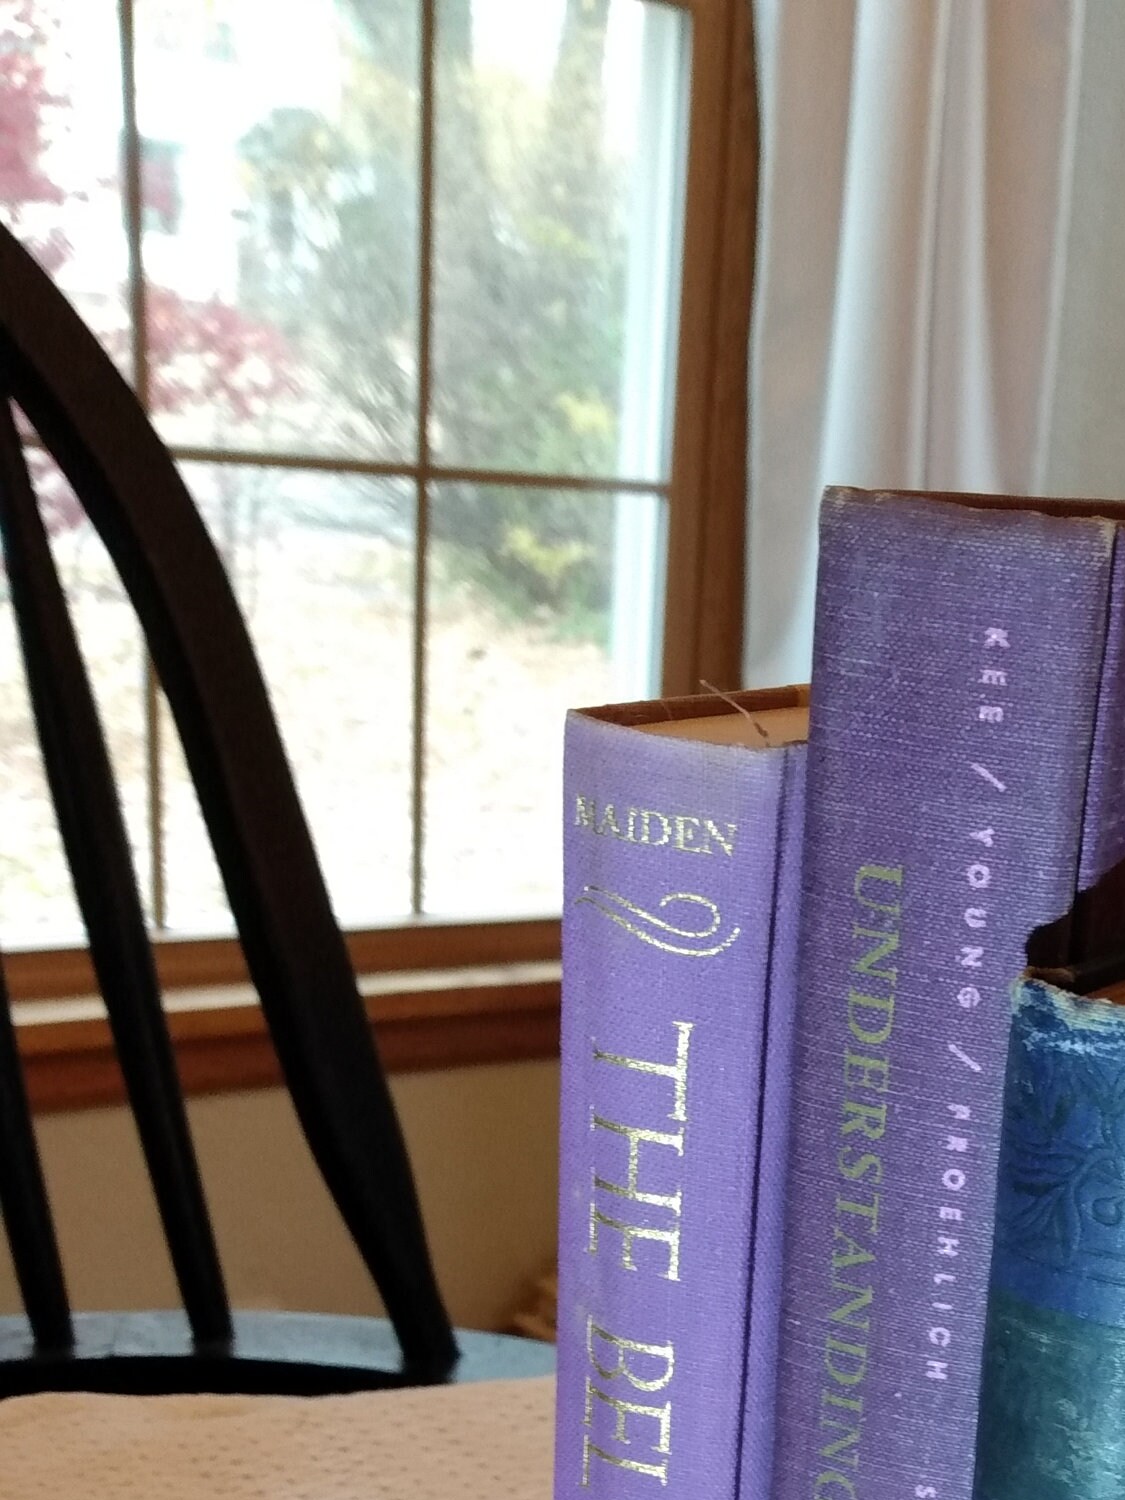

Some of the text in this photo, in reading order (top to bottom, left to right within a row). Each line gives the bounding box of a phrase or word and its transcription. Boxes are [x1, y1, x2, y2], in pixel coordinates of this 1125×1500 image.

[977, 626, 1010, 723] KEE
[574, 794, 738, 856] MAIDEN
[956, 828, 996, 1009] YOUNG
[587, 1020, 695, 1282] THE
